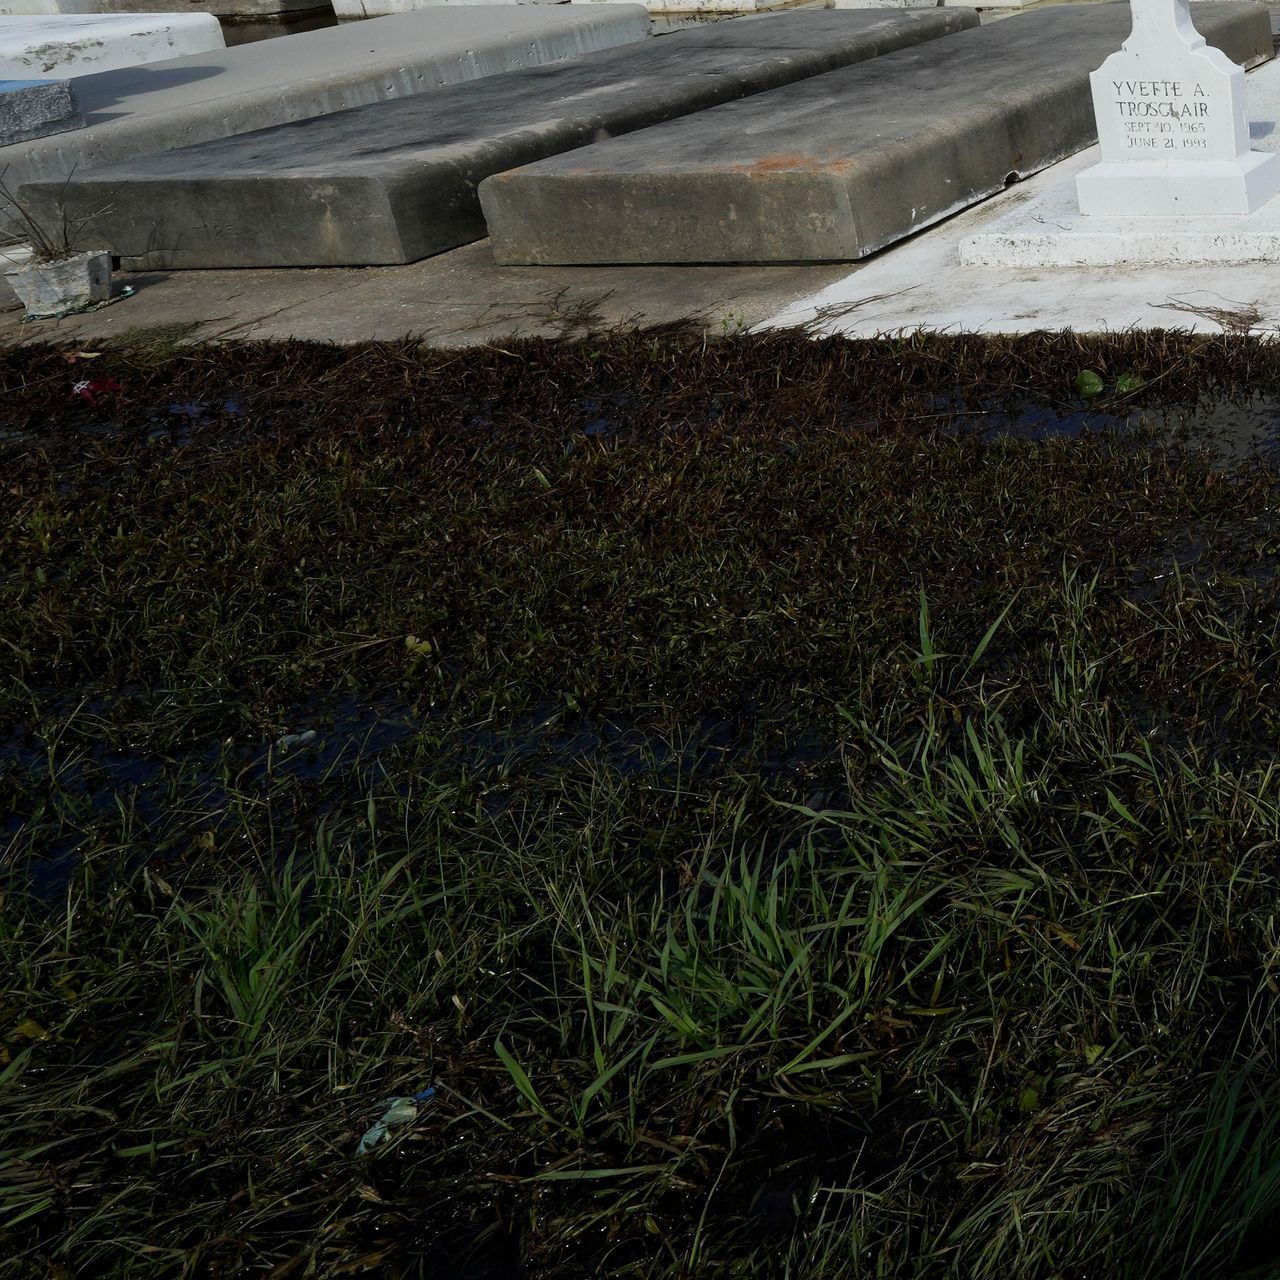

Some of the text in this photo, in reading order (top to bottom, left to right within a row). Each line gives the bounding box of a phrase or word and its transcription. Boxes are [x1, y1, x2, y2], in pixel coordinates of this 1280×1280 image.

[1112, 80, 1183, 97] YVETTE
[1115, 101, 1210, 118] TROSCLAIR
[1180, 122, 1206, 134] 1965
[1182, 138, 1207, 149] 1993
